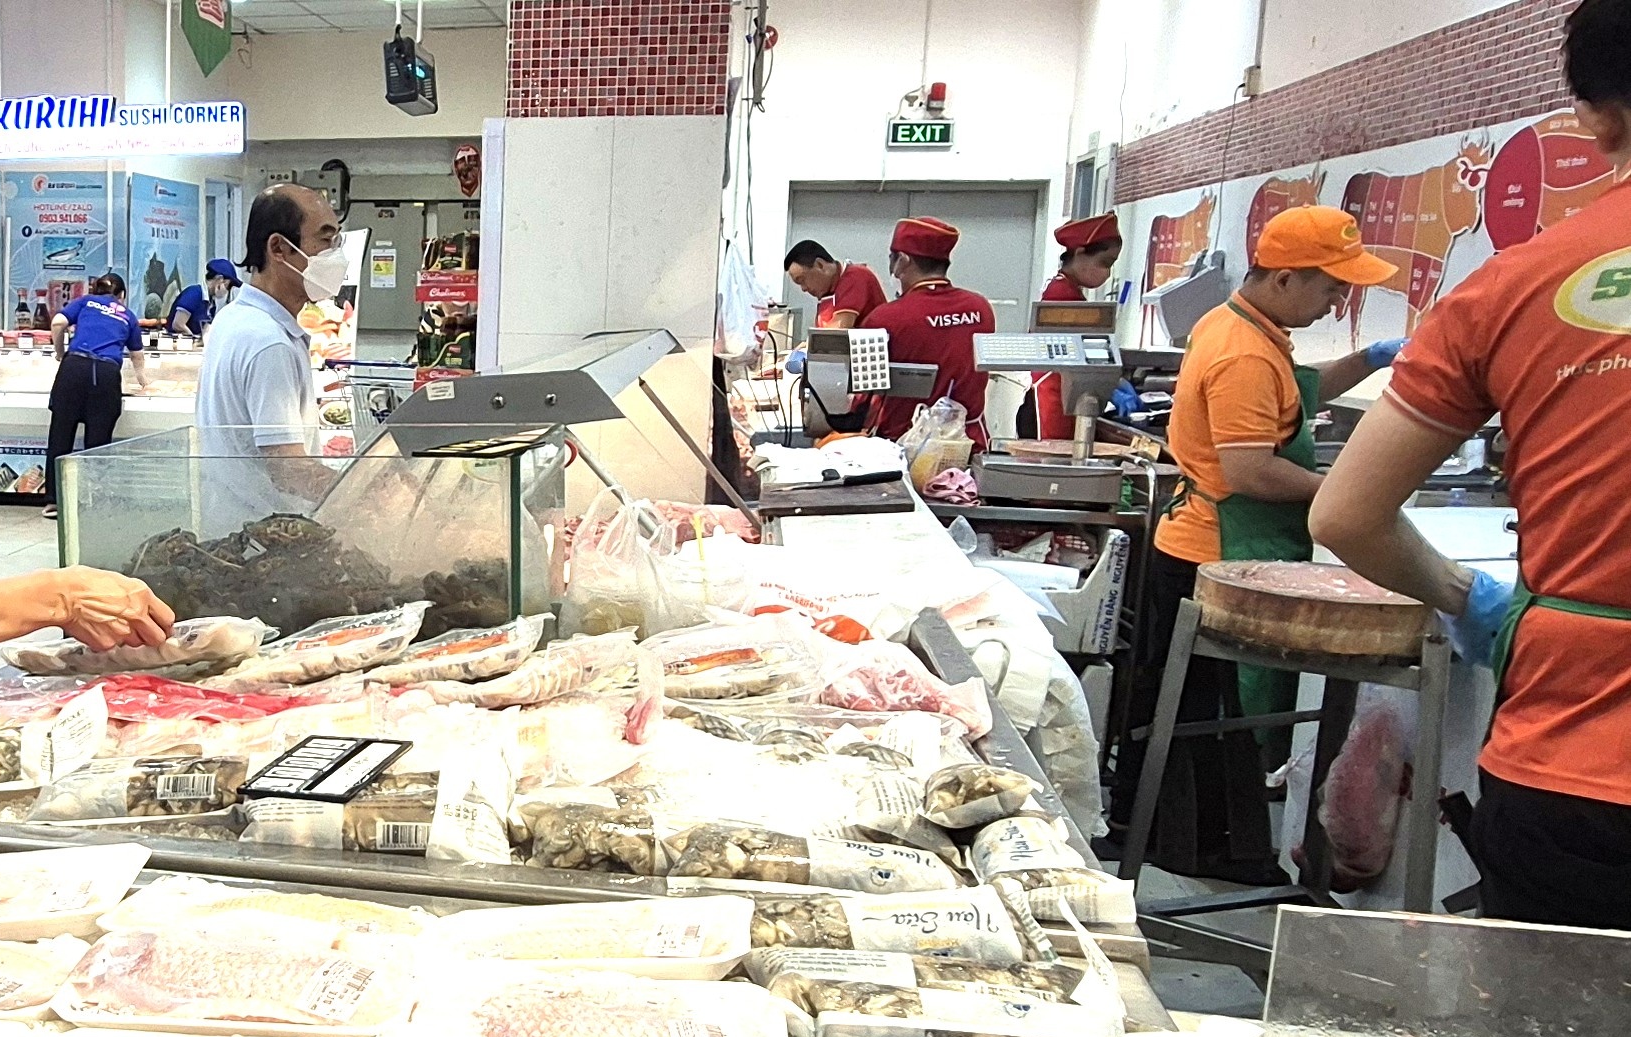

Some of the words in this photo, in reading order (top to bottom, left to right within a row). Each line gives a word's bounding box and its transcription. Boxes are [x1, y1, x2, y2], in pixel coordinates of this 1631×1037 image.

[119, 109, 168, 127] SUSHI
[173, 105, 241, 125] CORNER
[897, 125, 945, 142] EXIT
[429, 286, 467, 298] Cholimex
[926, 311, 981, 328] VISSAN
